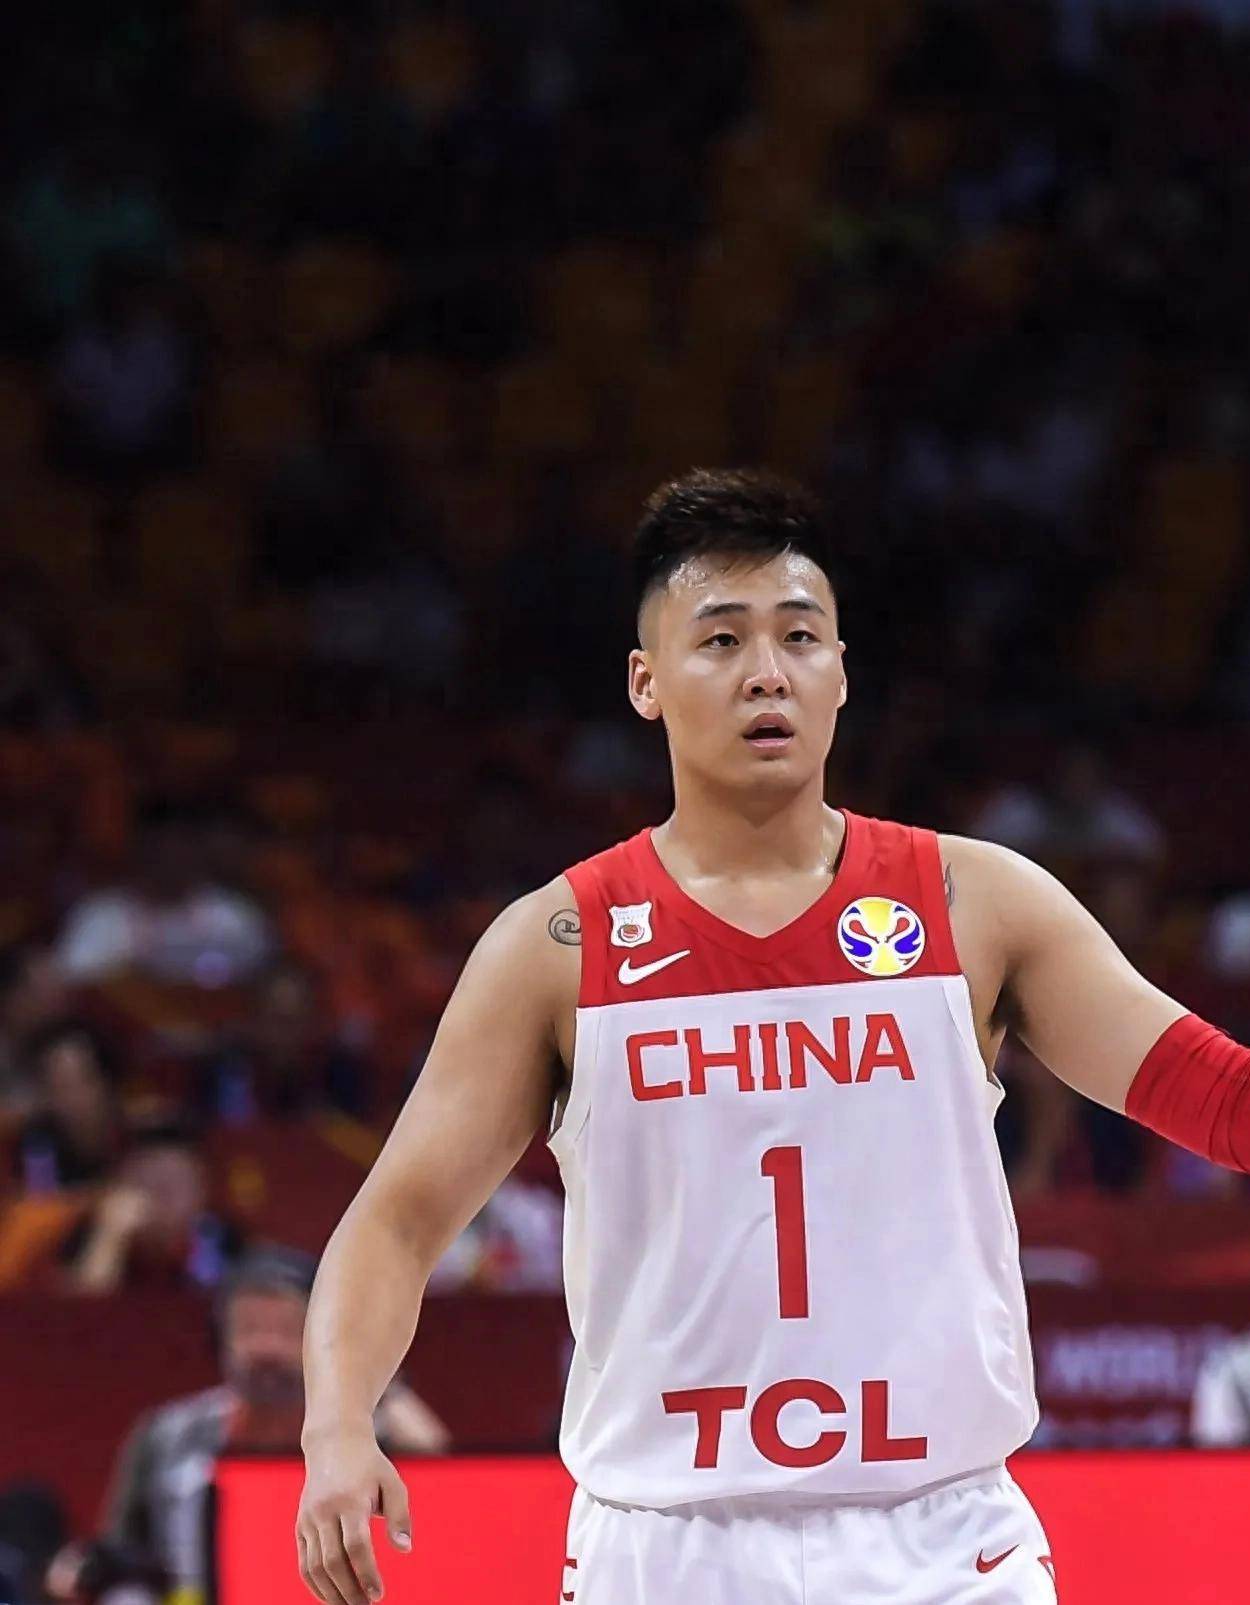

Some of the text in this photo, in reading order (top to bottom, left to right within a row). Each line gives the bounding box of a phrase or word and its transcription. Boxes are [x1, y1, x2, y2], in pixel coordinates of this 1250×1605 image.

[625, 1013, 916, 1102] CHINA
[760, 1145, 809, 1319] 1
[661, 1378, 928, 1469] TCL
